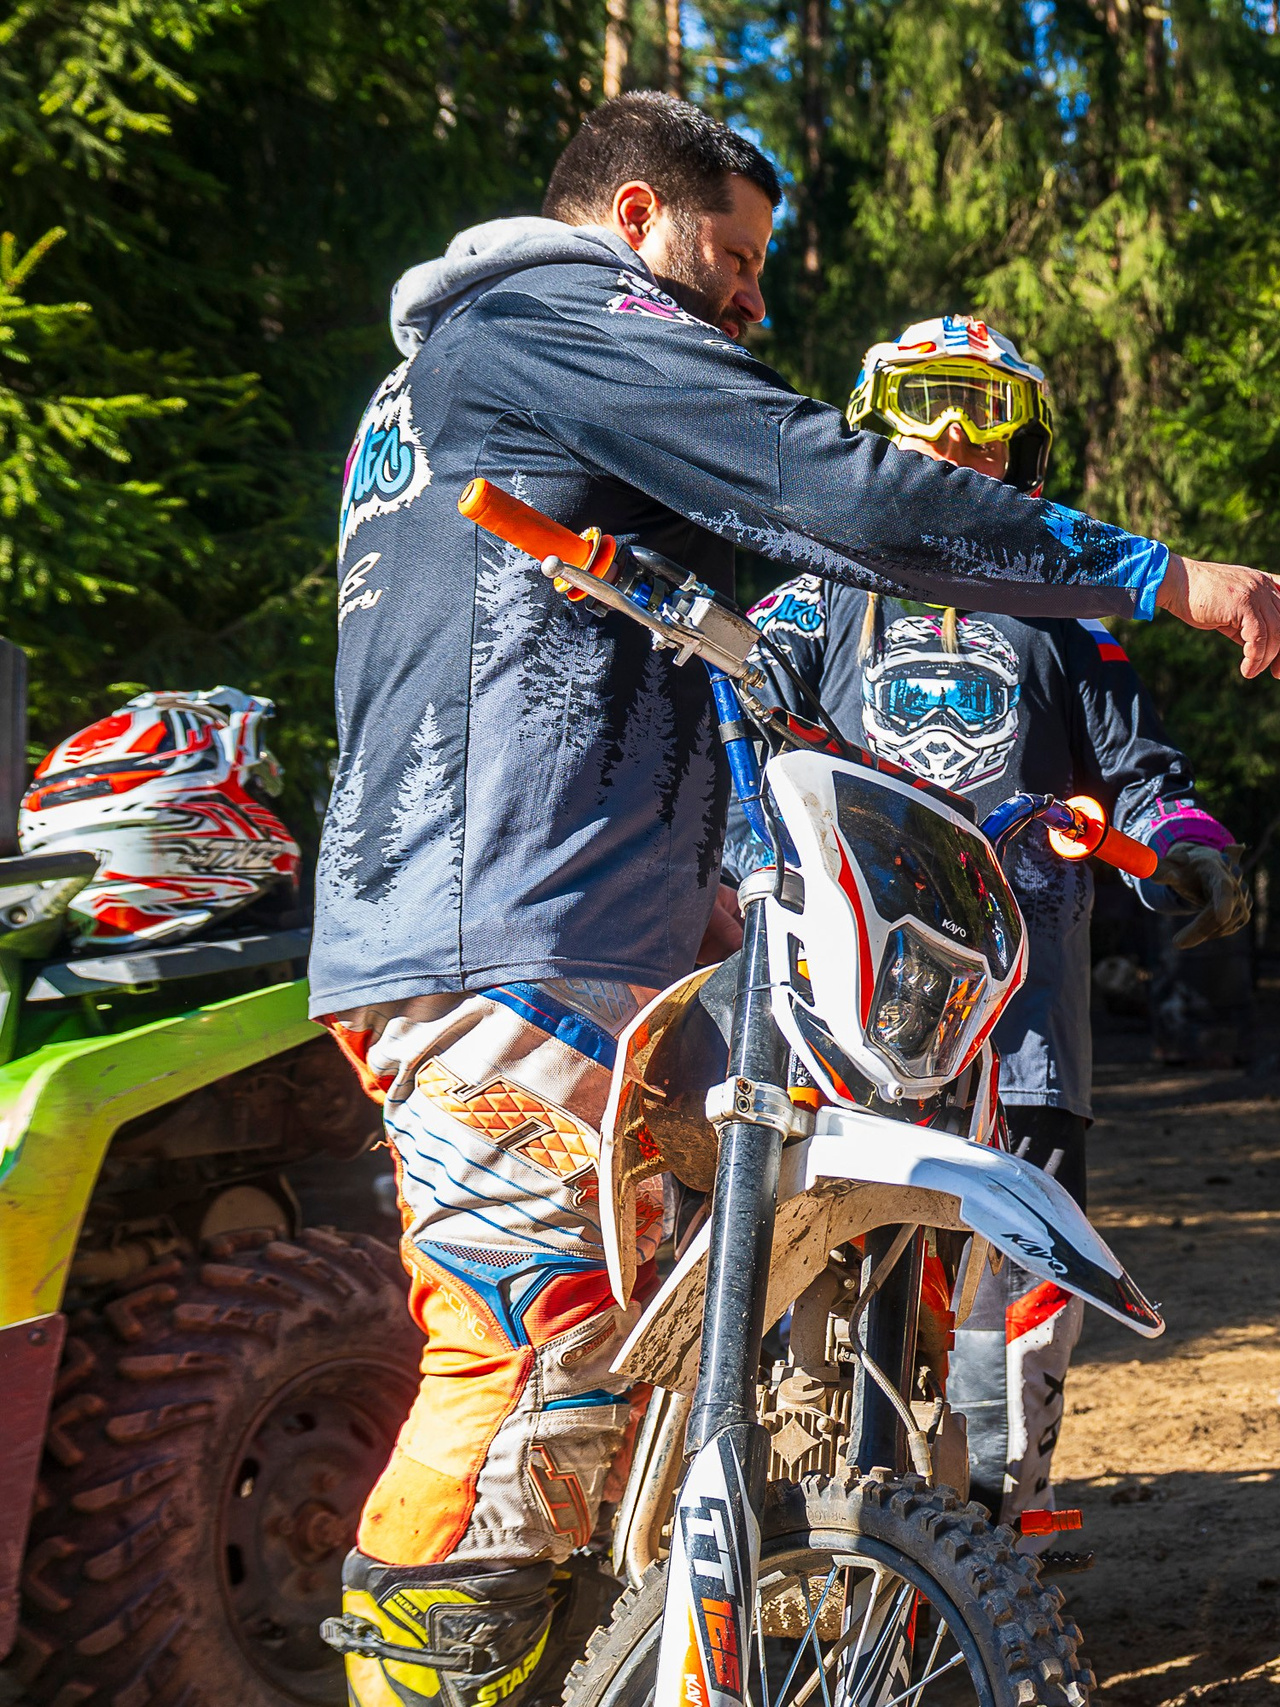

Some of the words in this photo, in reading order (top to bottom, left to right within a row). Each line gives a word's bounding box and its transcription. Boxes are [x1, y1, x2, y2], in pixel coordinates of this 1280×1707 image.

[941, 918, 967, 938] KAYO
[1001, 1233, 1069, 1275] KAYO
[684, 1673, 702, 1707] KAY
